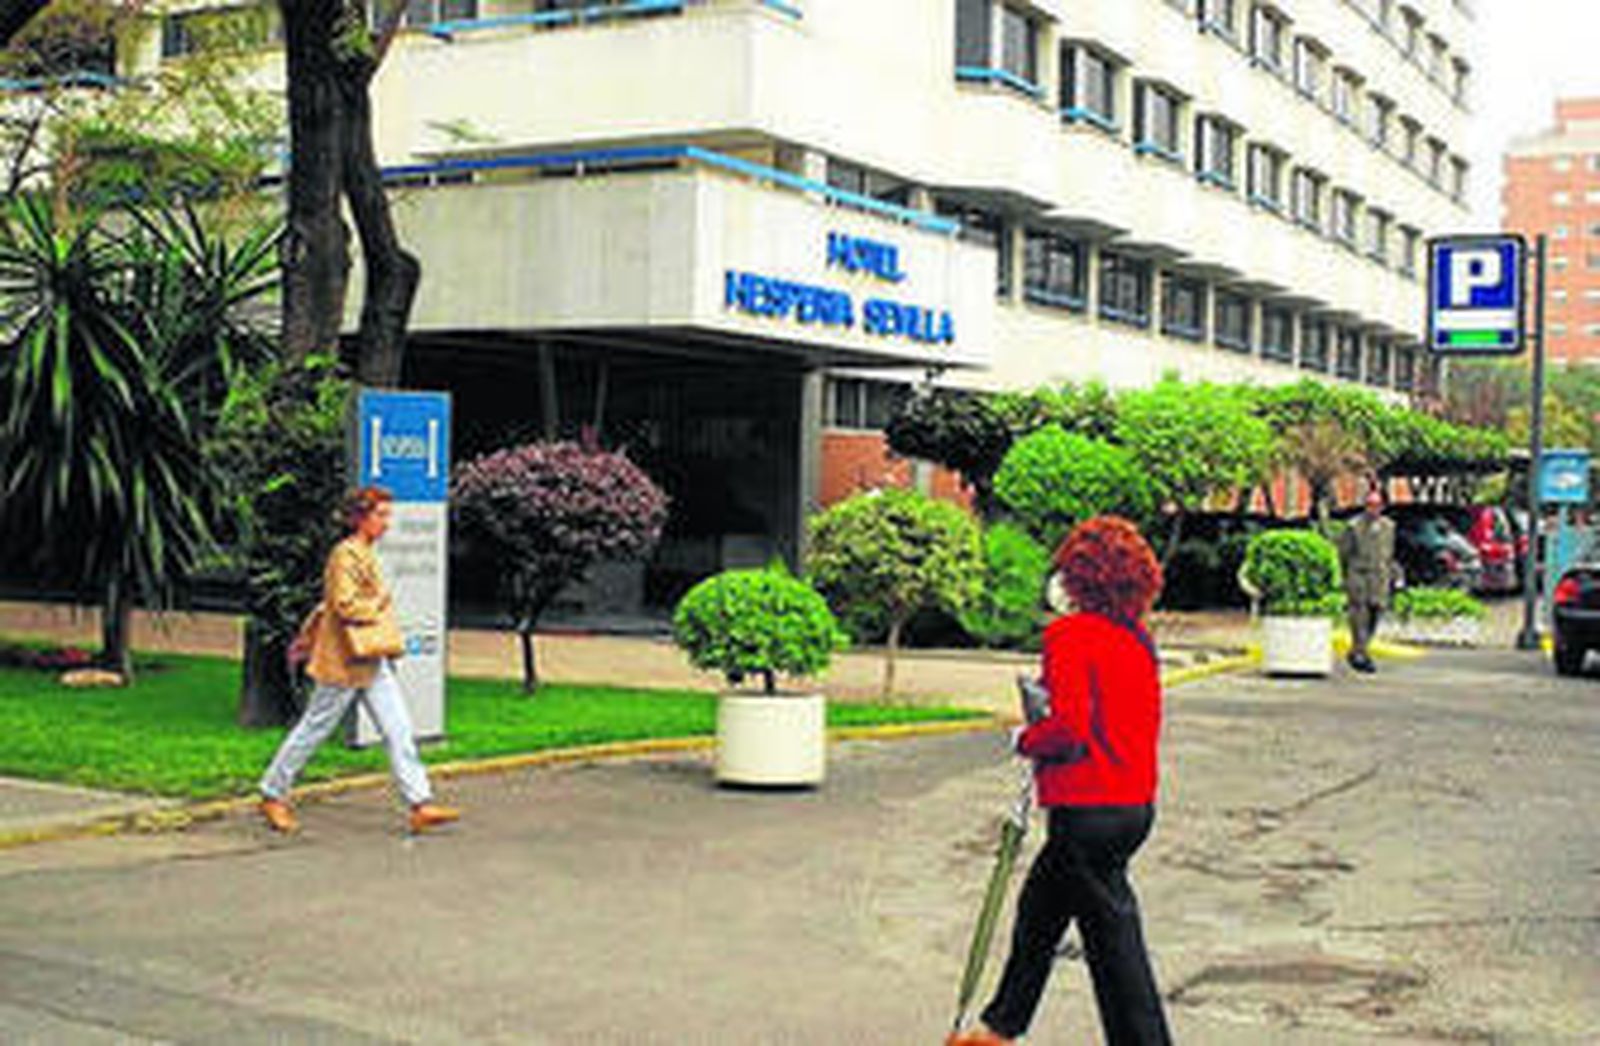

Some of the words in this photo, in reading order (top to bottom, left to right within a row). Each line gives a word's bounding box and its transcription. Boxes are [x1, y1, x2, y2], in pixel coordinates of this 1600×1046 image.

[827, 231, 905, 282] HOTEL
[1451, 250, 1502, 305] P
[863, 297, 954, 343] SEVILLA
